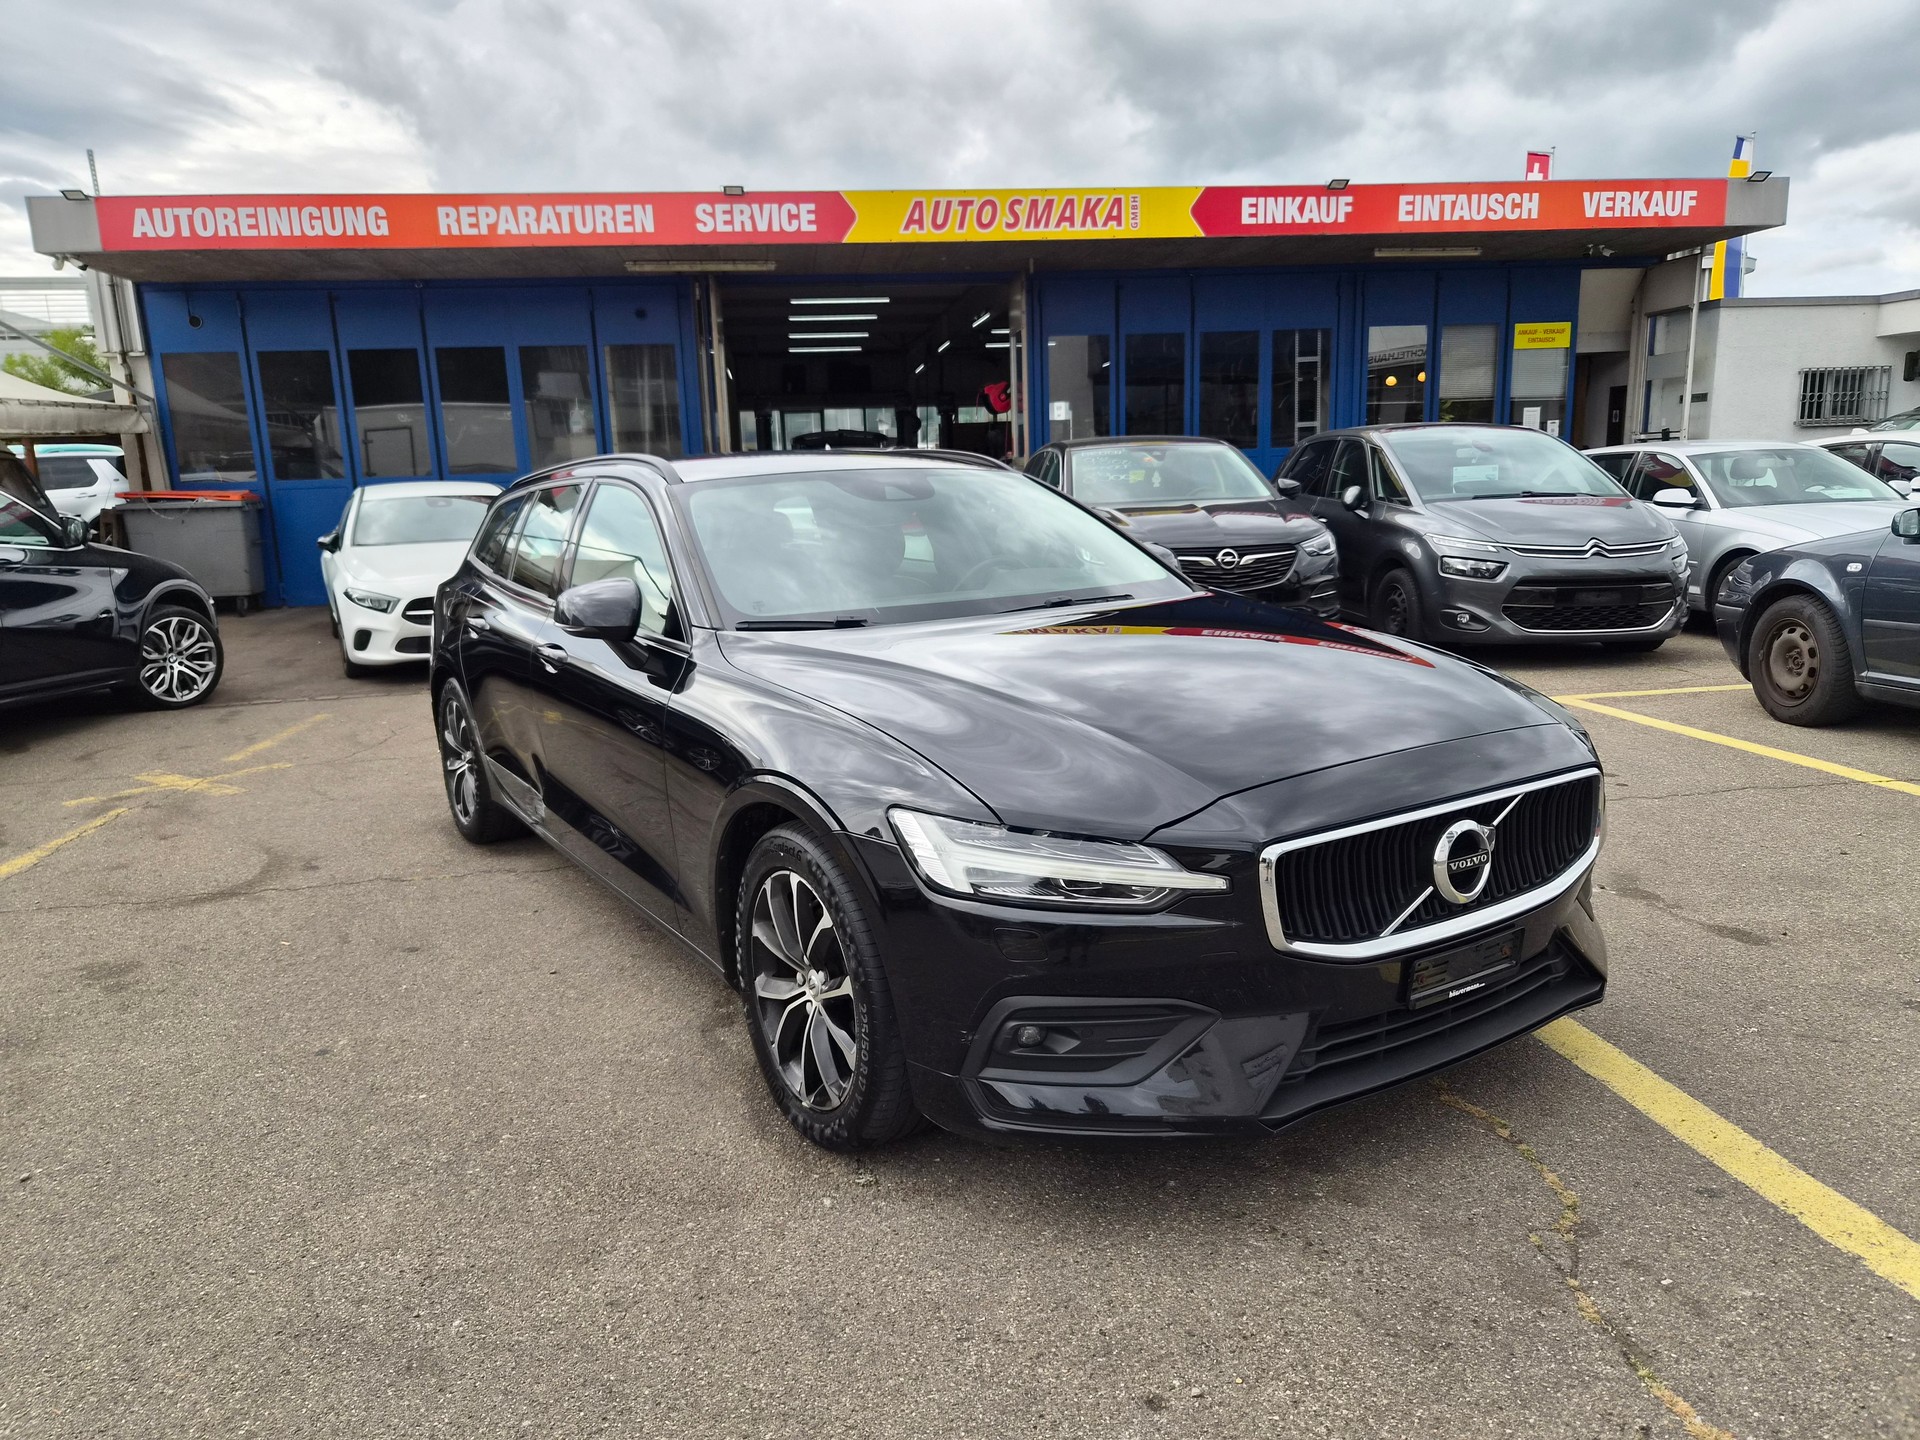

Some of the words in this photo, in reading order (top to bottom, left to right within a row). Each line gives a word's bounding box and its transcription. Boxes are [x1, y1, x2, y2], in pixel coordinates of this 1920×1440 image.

[695, 203, 817, 233] SERVICE
[902, 198, 999, 232] AUTO
[1003, 195, 1125, 231] SMAKA
[1130, 195, 1140, 229] GMBH
[1241, 196, 1353, 224] EINKAUF
[1398, 193, 1539, 222] EINTAUSCH
[1583, 190, 1698, 218] VERKAUF
[132, 206, 389, 238] AUTOREINIGUNG
[437, 204, 655, 236] REPARATUREN
[1449, 854, 1487, 870] VOLVO
[859, 1003, 869, 1061] 225/50
[860, 1062, 868, 1075] R
[859, 1076, 866, 1091] 17
